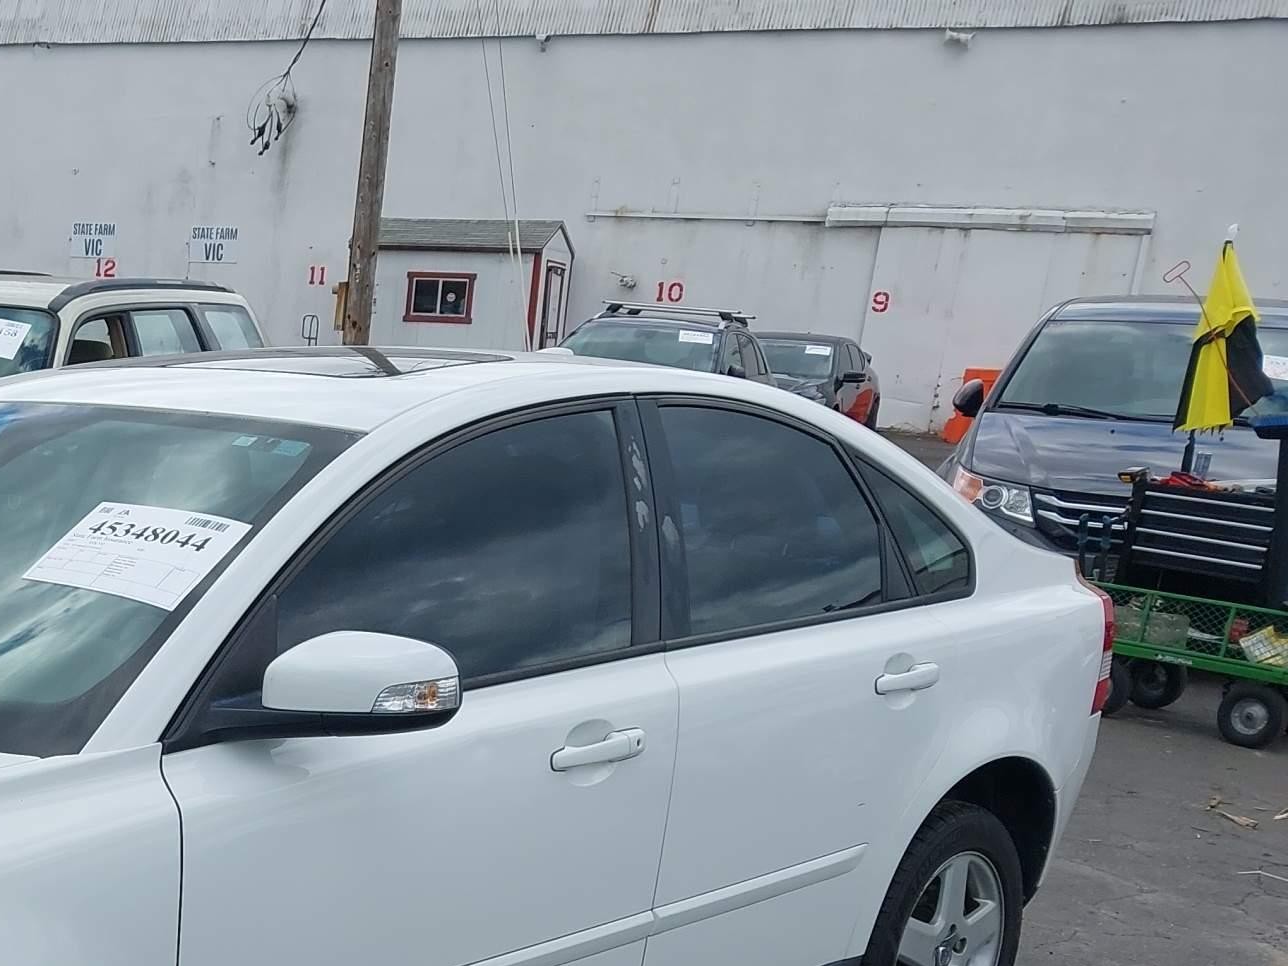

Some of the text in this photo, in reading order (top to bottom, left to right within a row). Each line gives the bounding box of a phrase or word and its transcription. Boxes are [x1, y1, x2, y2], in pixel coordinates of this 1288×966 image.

[73, 223, 115, 236] STATE FARM
[192, 227, 238, 241] STATE FARM
[84, 238, 102, 256] VIC
[204, 242, 224, 261] VIC
[95, 258, 116, 277] 12
[309, 266, 325, 286] 11
[656, 281, 684, 303] 10
[871, 291, 890, 312] 9
[88, 520, 213, 552] 45348044
